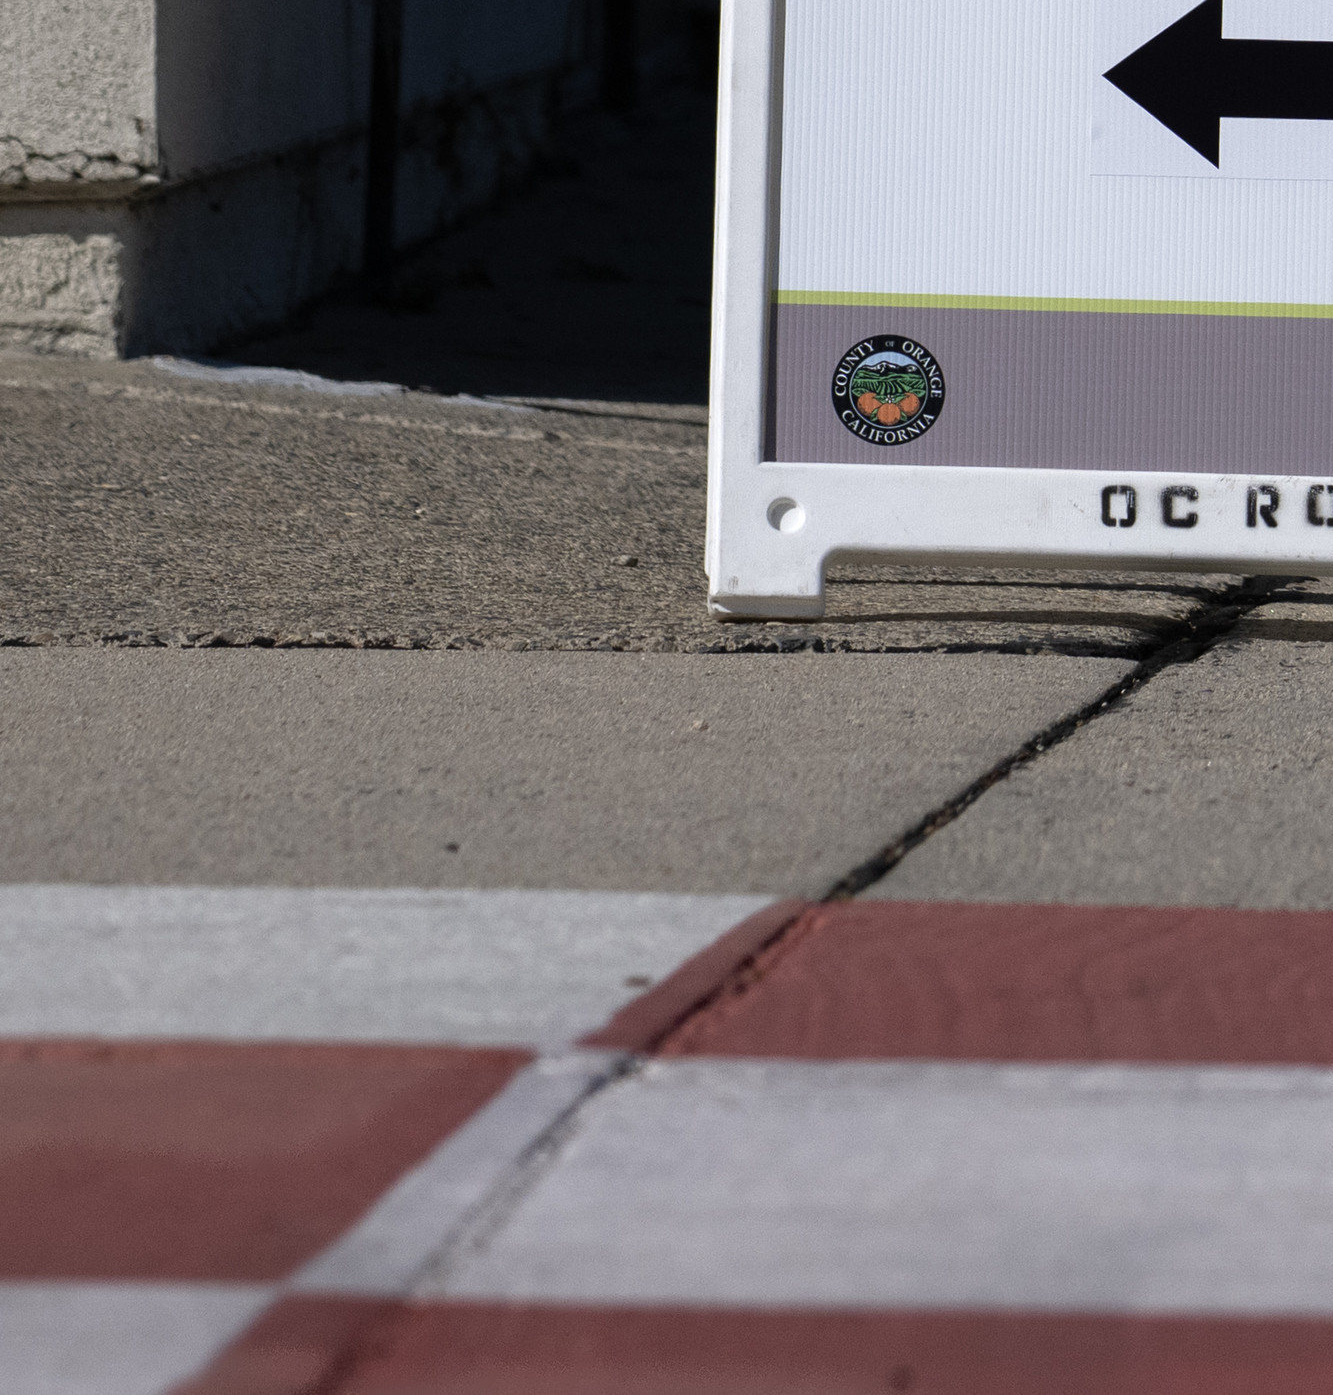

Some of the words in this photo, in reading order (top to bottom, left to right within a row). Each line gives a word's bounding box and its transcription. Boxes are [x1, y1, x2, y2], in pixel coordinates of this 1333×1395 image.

[834, 339, 875, 397] COUNTY
[885, 340, 895, 348] OF
[902, 340, 943, 398] ORANGE
[841, 409, 935, 444] CALIFORNIA
[1101, 485, 1199, 529] OC
